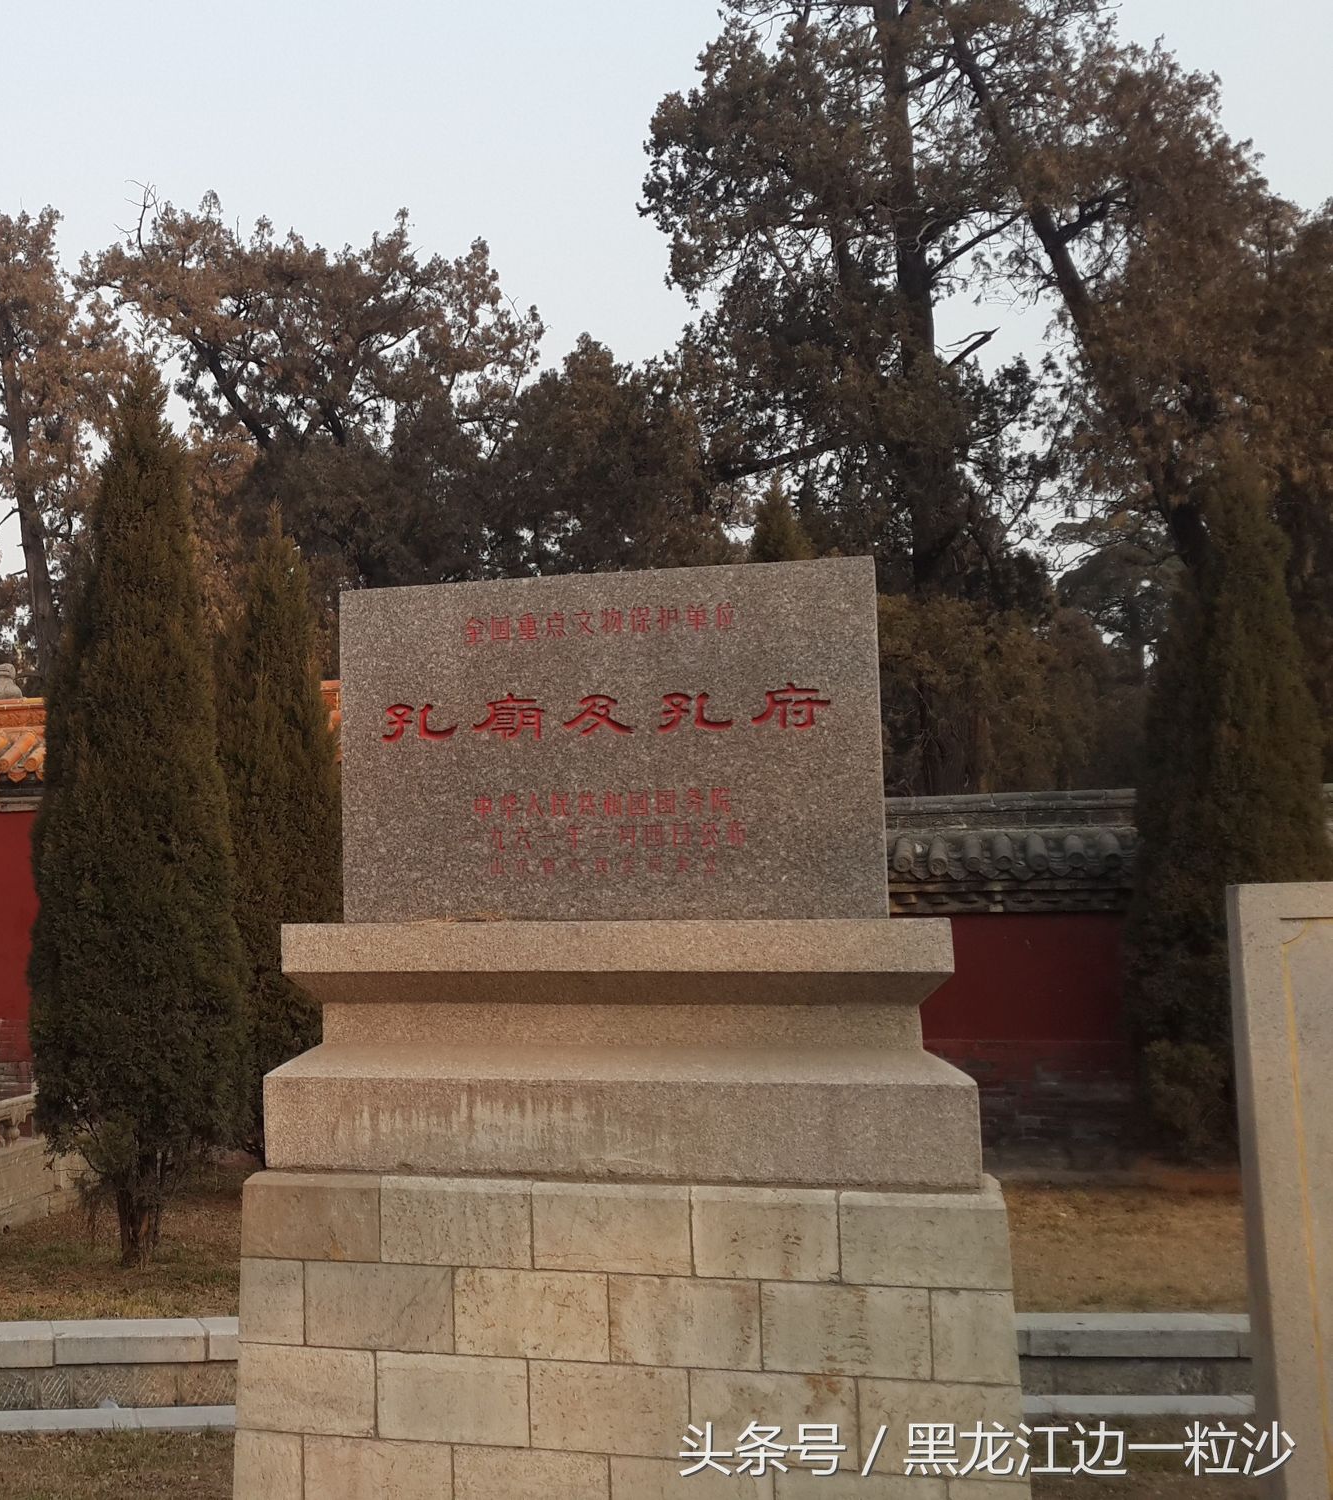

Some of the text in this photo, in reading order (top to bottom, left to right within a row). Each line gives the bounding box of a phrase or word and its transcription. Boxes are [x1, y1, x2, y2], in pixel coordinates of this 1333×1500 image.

[465, 603, 738, 646] 全国重点文物保护单位
[472, 787, 733, 820] 中华人民共和国国务院
[461, 819, 748, 853] 一九六一年三月四日公布
